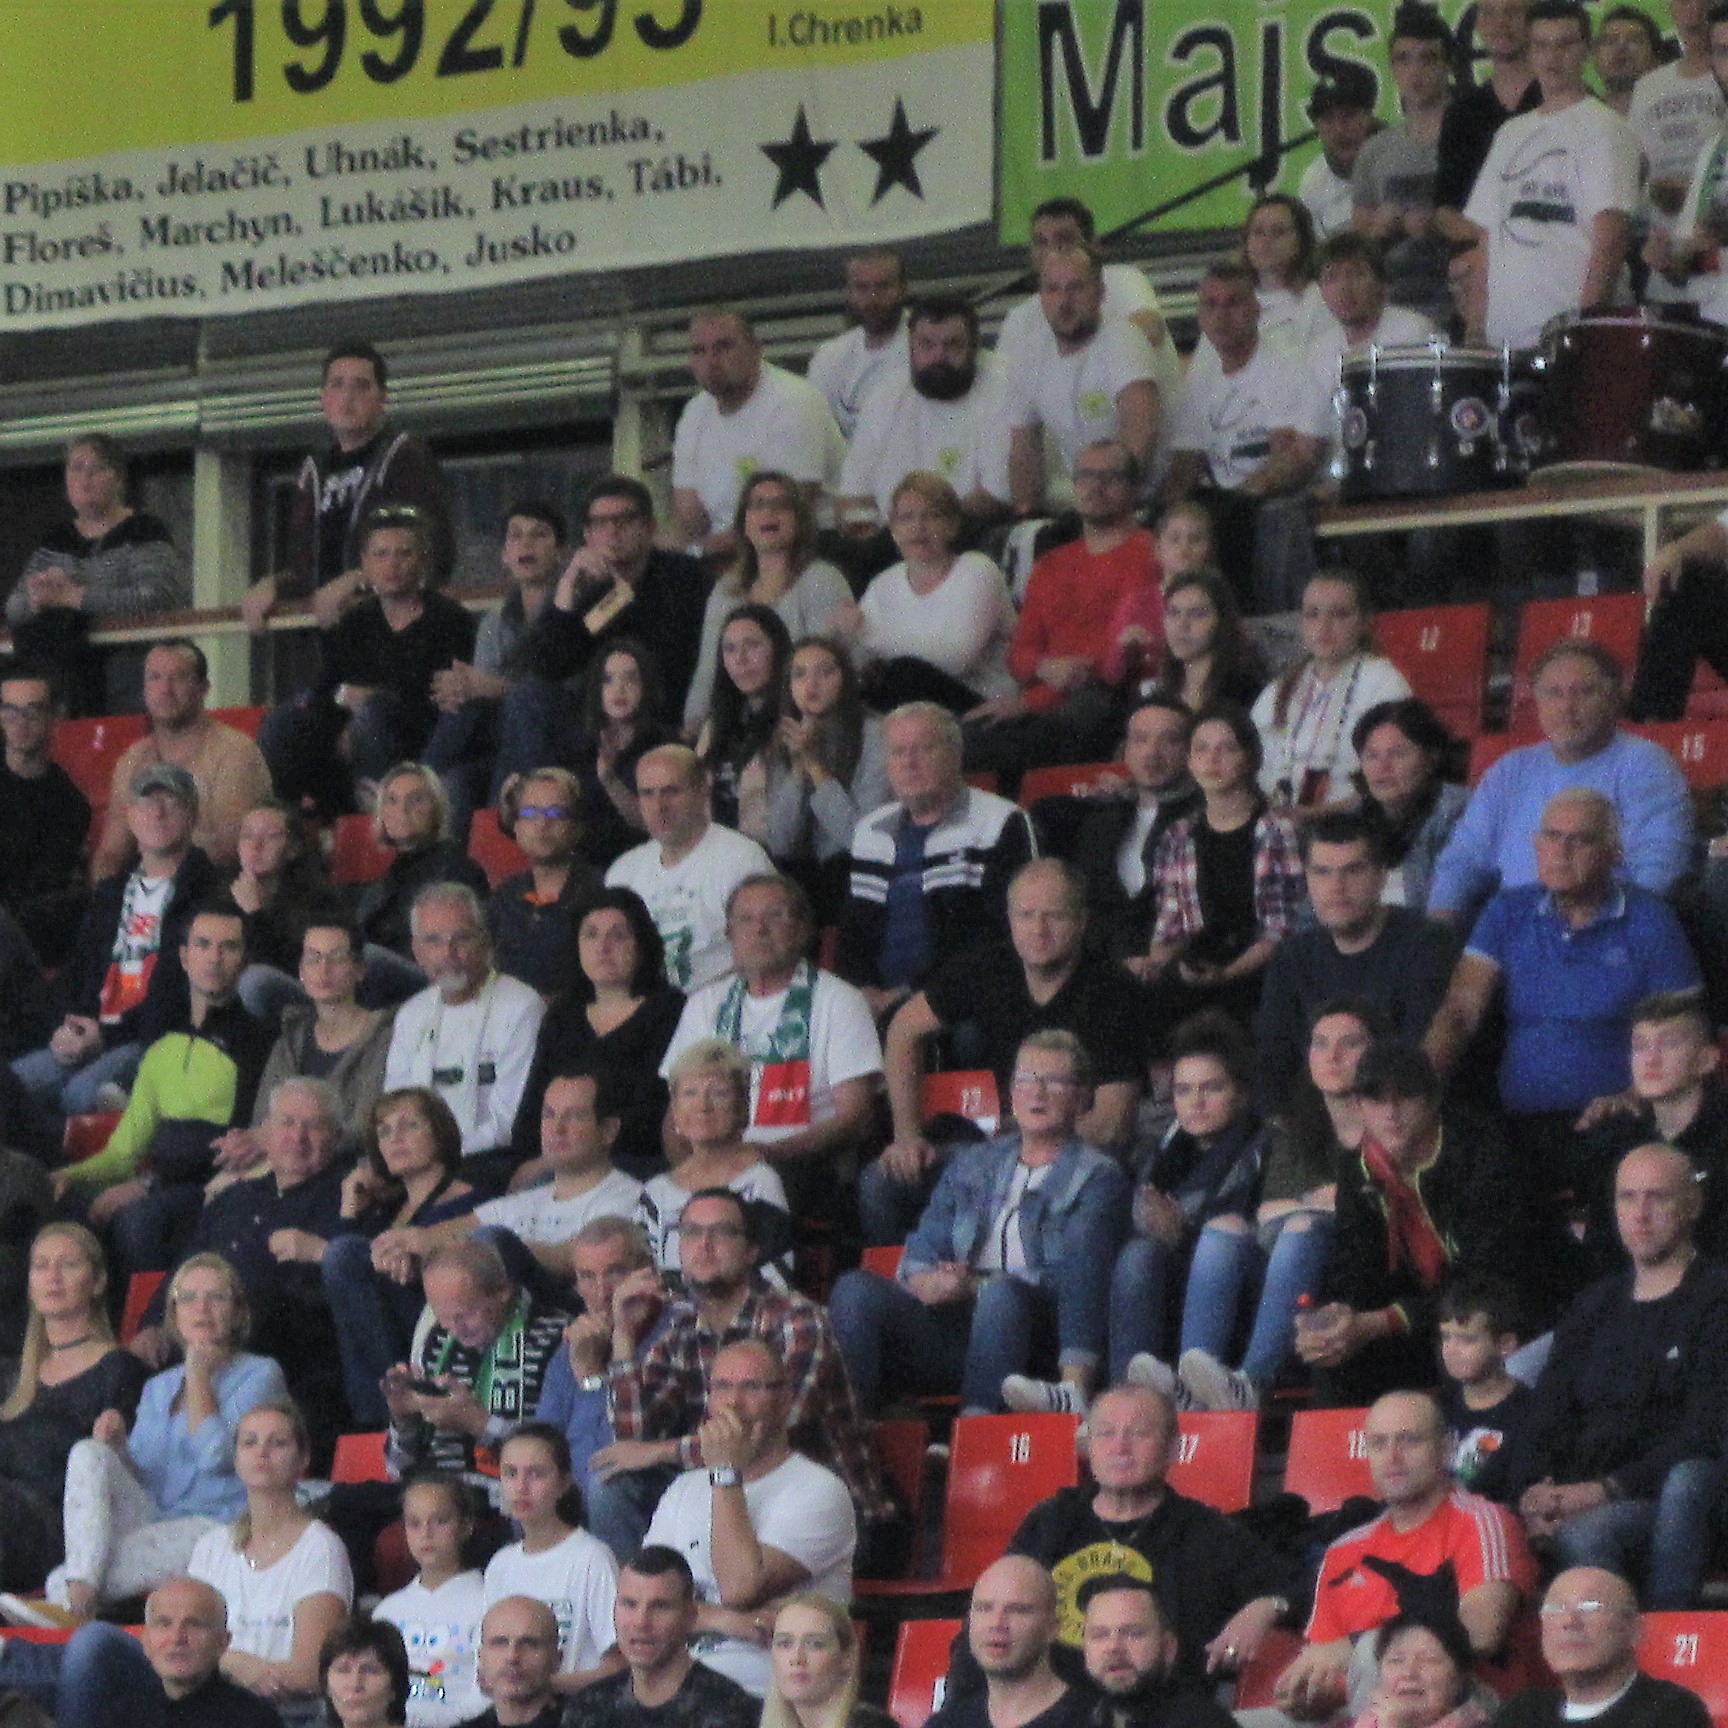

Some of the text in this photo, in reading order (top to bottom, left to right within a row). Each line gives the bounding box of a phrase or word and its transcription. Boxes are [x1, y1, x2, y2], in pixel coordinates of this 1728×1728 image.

[453, 110, 666, 165] Sestrienka,
[2, 221, 125, 265] Floreš,
[320, 184, 477, 229] Lukášik,
[491, 173, 616, 213] Kraus,
[464, 224, 577, 269] Jusko
